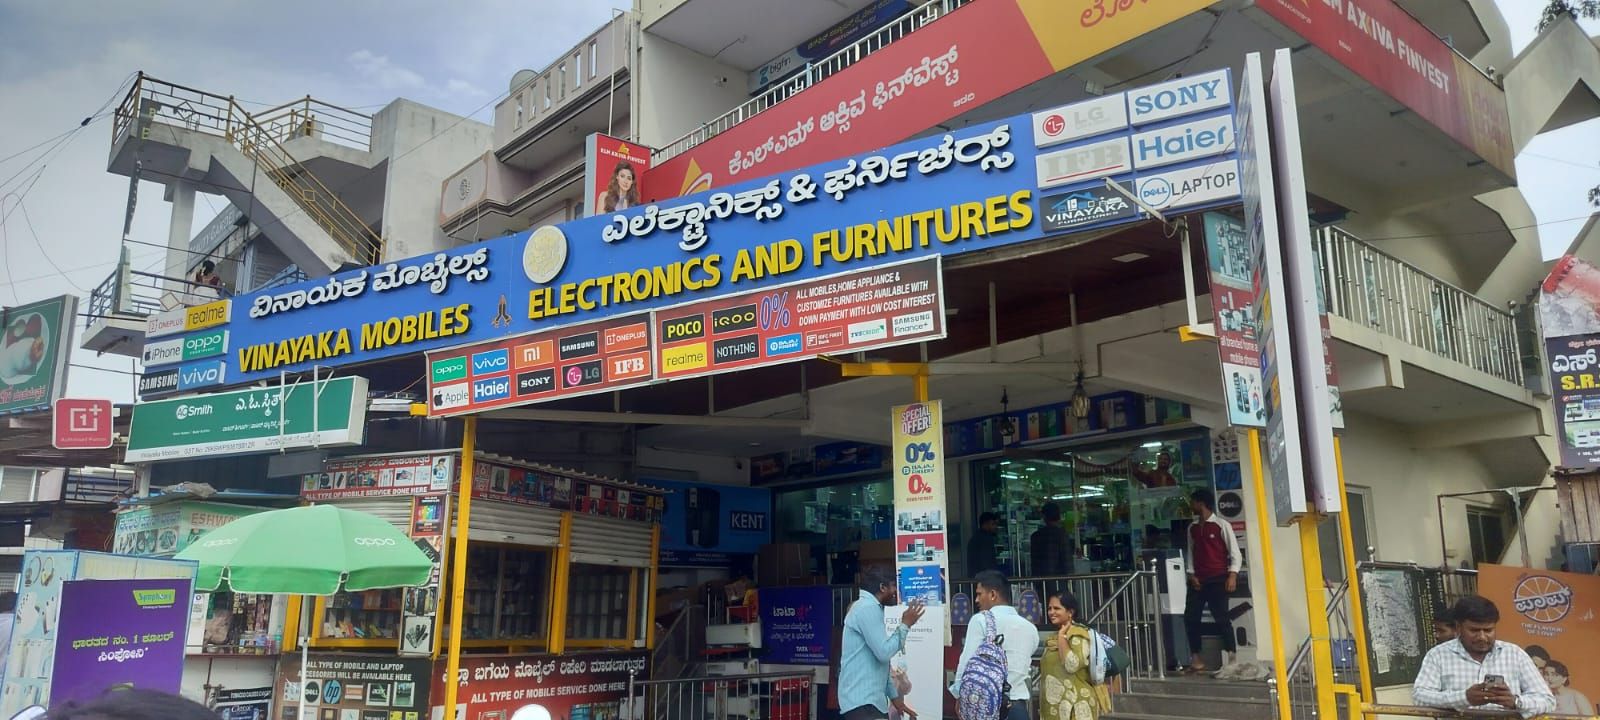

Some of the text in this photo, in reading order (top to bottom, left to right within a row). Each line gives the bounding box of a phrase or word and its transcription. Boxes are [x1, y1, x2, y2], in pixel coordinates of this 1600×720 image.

[769, 57, 791, 74] bigfin
[1397, 37, 1449, 95] FINVEST
[1134, 79, 1221, 115] SONY
[1074, 107, 1105, 125] LG
[1138, 126, 1227, 161] Haier
[1045, 143, 1124, 174] IFB
[1143, 171, 1236, 197] DELL LAPTOP
[1046, 199, 1129, 223] VINAYAKA
[249, 268, 368, 318] ವಿನಾಯಕ
[372, 247, 490, 294] ಮೊಬೈಲ್ಸ್
[786, 173, 817, 203] &
[239, 190, 1033, 373] VINAYAKA MOBILES ELECTRONICS AND FURNITURES
[796, 290, 808, 300] ALL
[857, 273, 897, 289] APPLIANCE
[894, 271, 901, 282] &
[796, 279, 929, 314] CUSTOMIZE FURNITURES AVAILABLE WITH
[188, 305, 225, 326] realme
[760, 292, 791, 331] 0%
[799, 292, 937, 327] DOWN PAYMENT WITH LOW COST INTEREST
[714, 311, 755, 328] iQOO
[894, 313, 931, 325] SAMSUNG
[615, 331, 646, 343] ONEPLUS
[667, 320, 702, 338] POCO
[186, 335, 222, 350] oppo
[561, 340, 595, 352] SAMSUNG
[716, 341, 756, 358] NOTHING
[151, 346, 181, 361] iPhone
[666, 351, 704, 367] realme
[435, 363, 464, 374] oppo
[474, 356, 507, 369] vivo
[614, 356, 645, 375] IFB
[183, 368, 218, 385] vivo
[585, 367, 600, 379] LG
[139, 373, 179, 391] SAMSUNG
[474, 381, 509, 398] Haier
[521, 376, 551, 388] SONY
[1561, 374, 1600, 391] S.R.
[445, 389, 469, 404] Apple
[188, 404, 213, 416] Smith
[902, 406, 930, 421] SPECIAL
[901, 417, 931, 434] OFFER!
[905, 442, 935, 463] 0%
[317, 491, 331, 499] TYPE
[342, 488, 364, 498] MOBILE
[393, 486, 410, 495] DONE
[411, 485, 428, 494] HERE
[908, 474, 932, 495] 0%
[731, 513, 765, 529] KENT
[354, 537, 396, 548] oppo
[343, 662, 366, 670] MOBILE
[361, 672, 394, 681] AVAILABLE
[395, 673, 412, 681] HERE
[326, 685, 340, 701] hp
[471, 681, 626, 704] ALL TYPE OF MOBILE SERVICE DONE HERE
